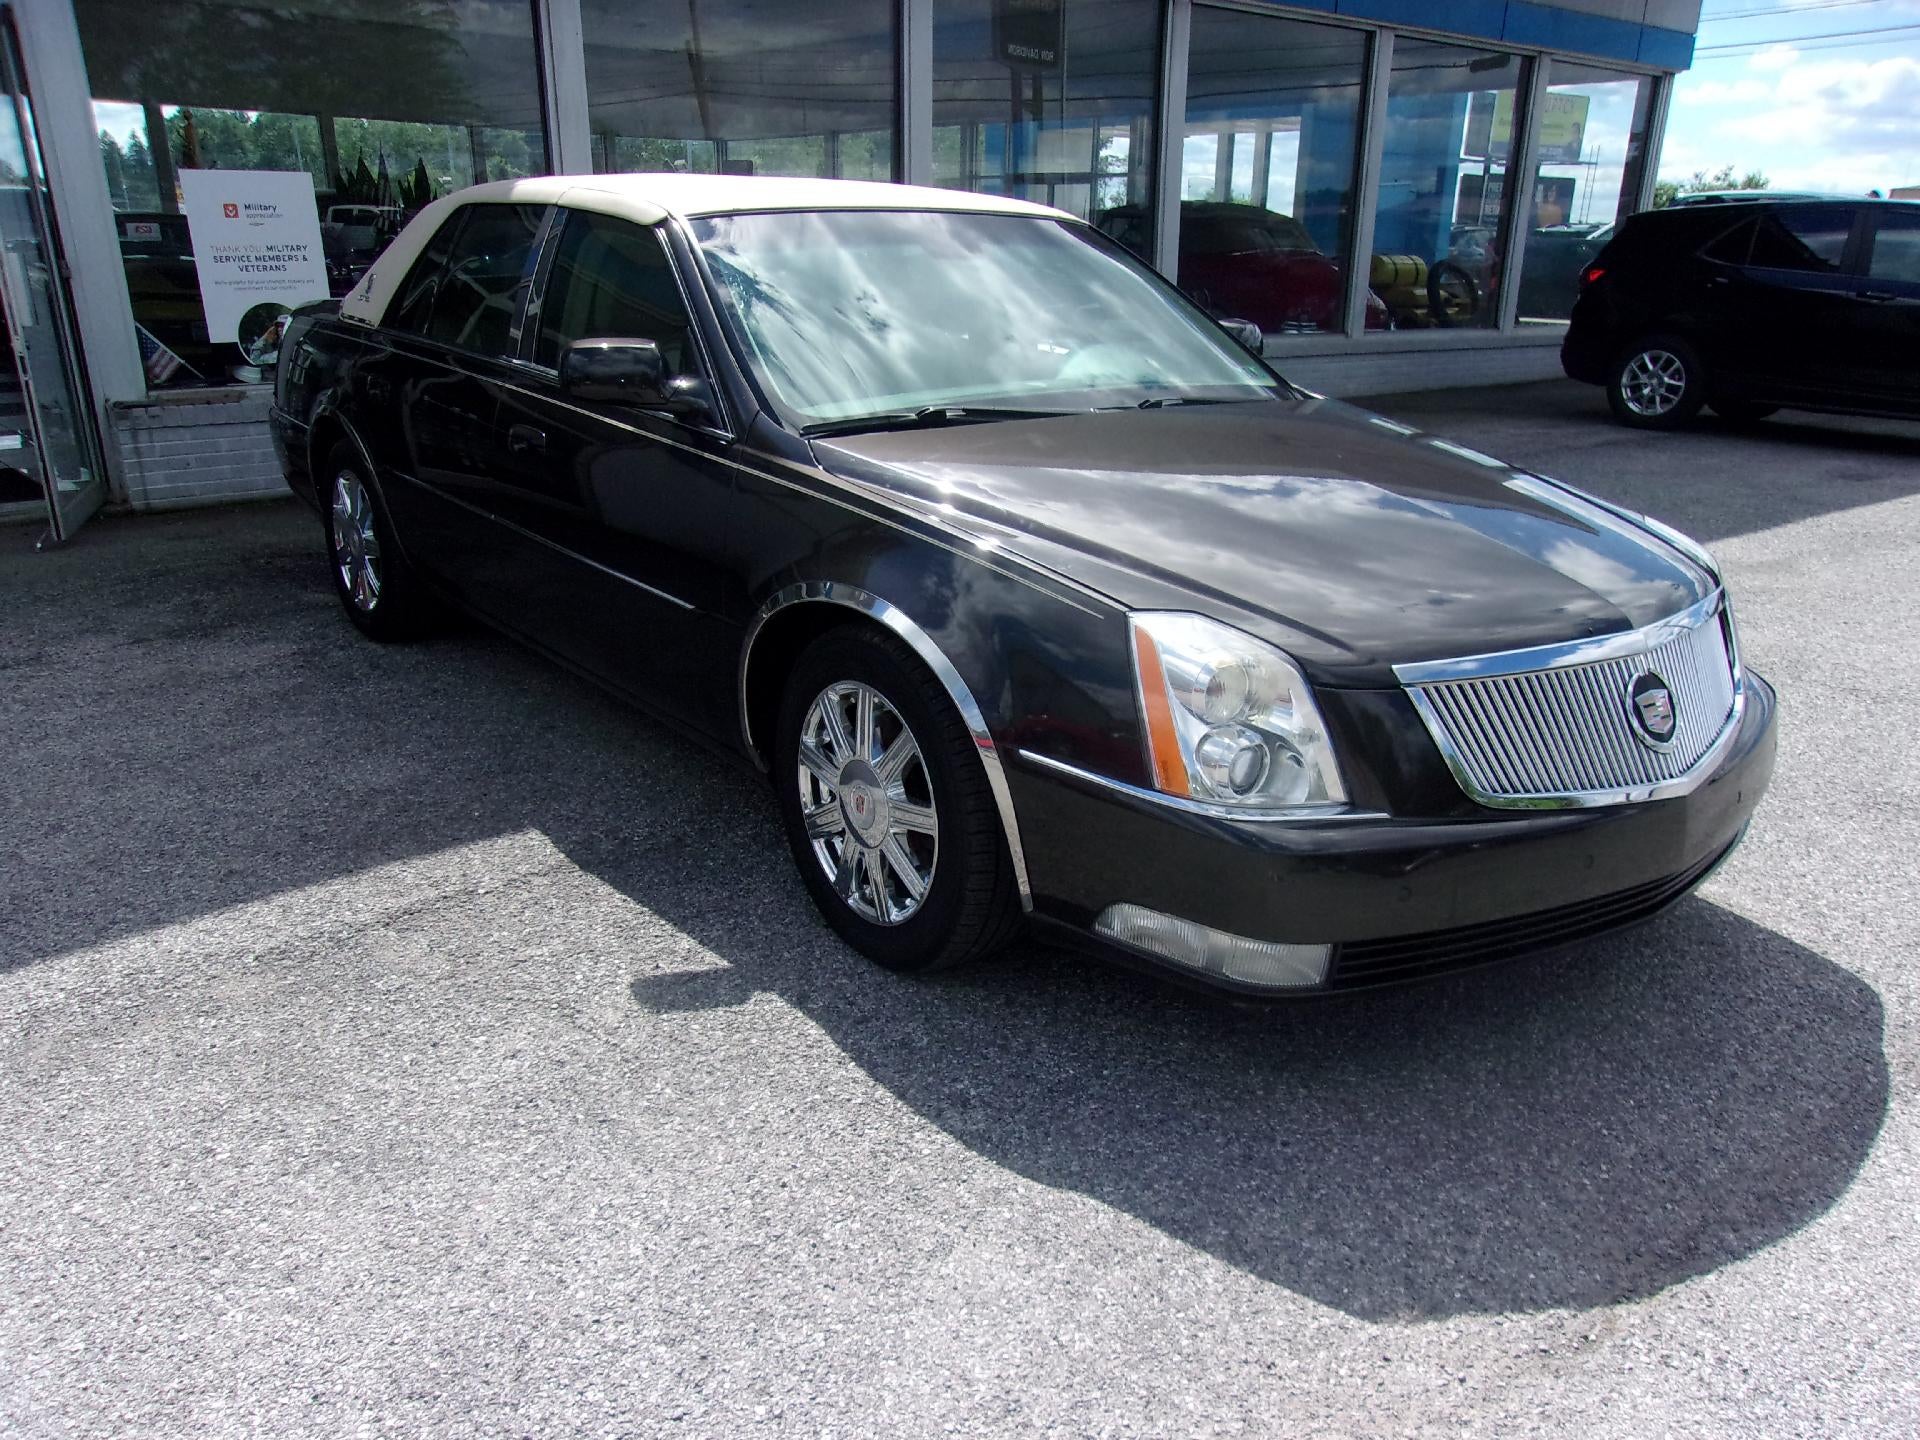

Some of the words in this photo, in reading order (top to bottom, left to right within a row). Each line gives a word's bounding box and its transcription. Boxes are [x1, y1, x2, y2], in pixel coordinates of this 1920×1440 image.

[244, 203, 277, 212] Military
[210, 245, 241, 254] THANK
[265, 244, 308, 253] MILITARY
[213, 255, 253, 264] SERVICE
[254, 254, 299, 263] MEMBERS
[302, 254, 308, 262] &
[238, 264, 287, 273] VETERANS
